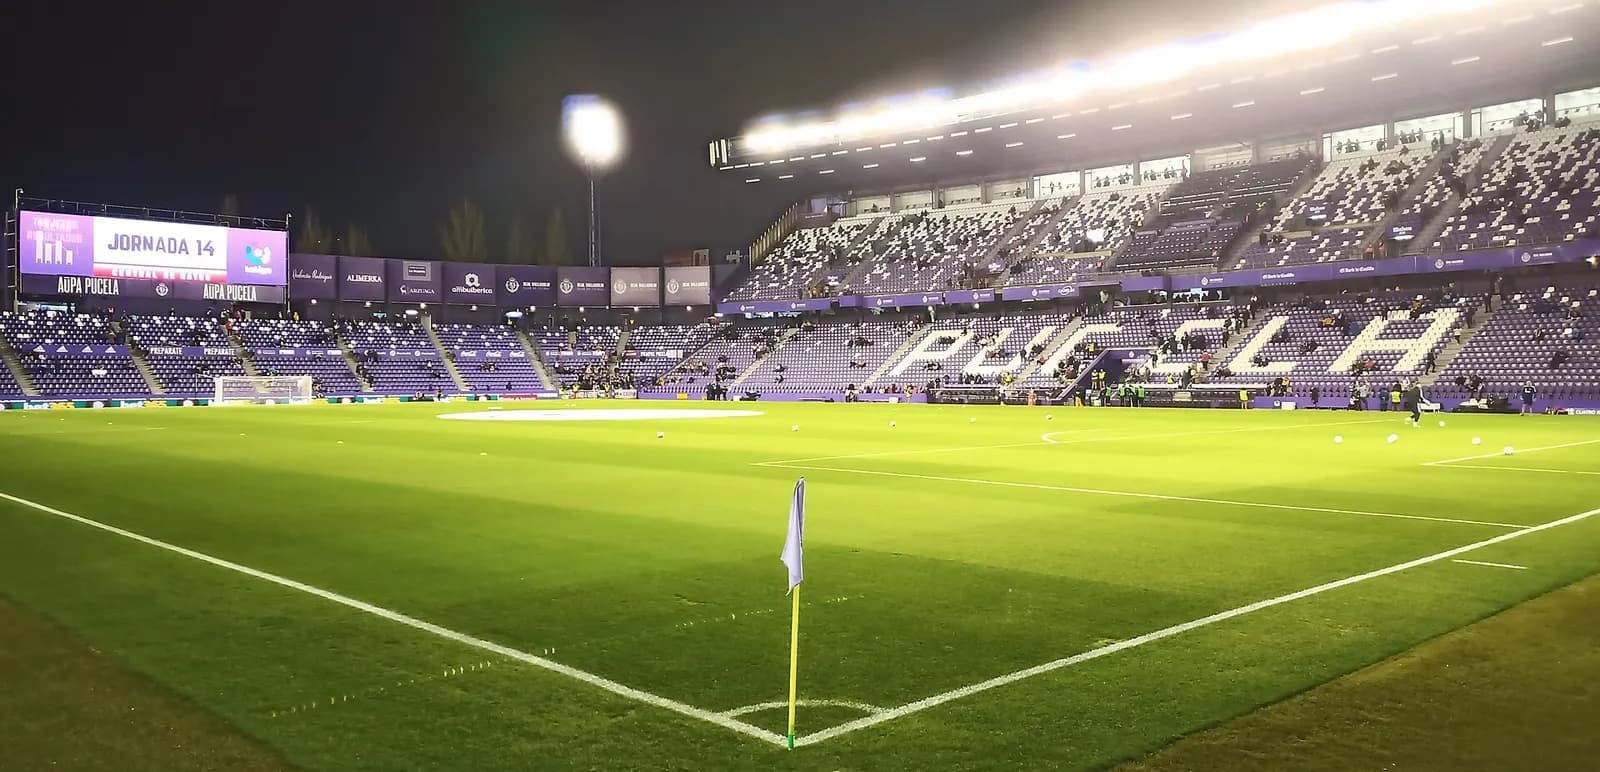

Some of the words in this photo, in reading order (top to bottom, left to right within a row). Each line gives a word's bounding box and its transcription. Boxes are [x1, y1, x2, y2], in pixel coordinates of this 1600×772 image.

[107, 233, 190, 255] JORNADA
[196, 239, 215, 257] 14
[84, 277, 120, 295] PUCELA
[346, 274, 383, 283] ALIMERKA
[226, 284, 257, 301] PUCELA
